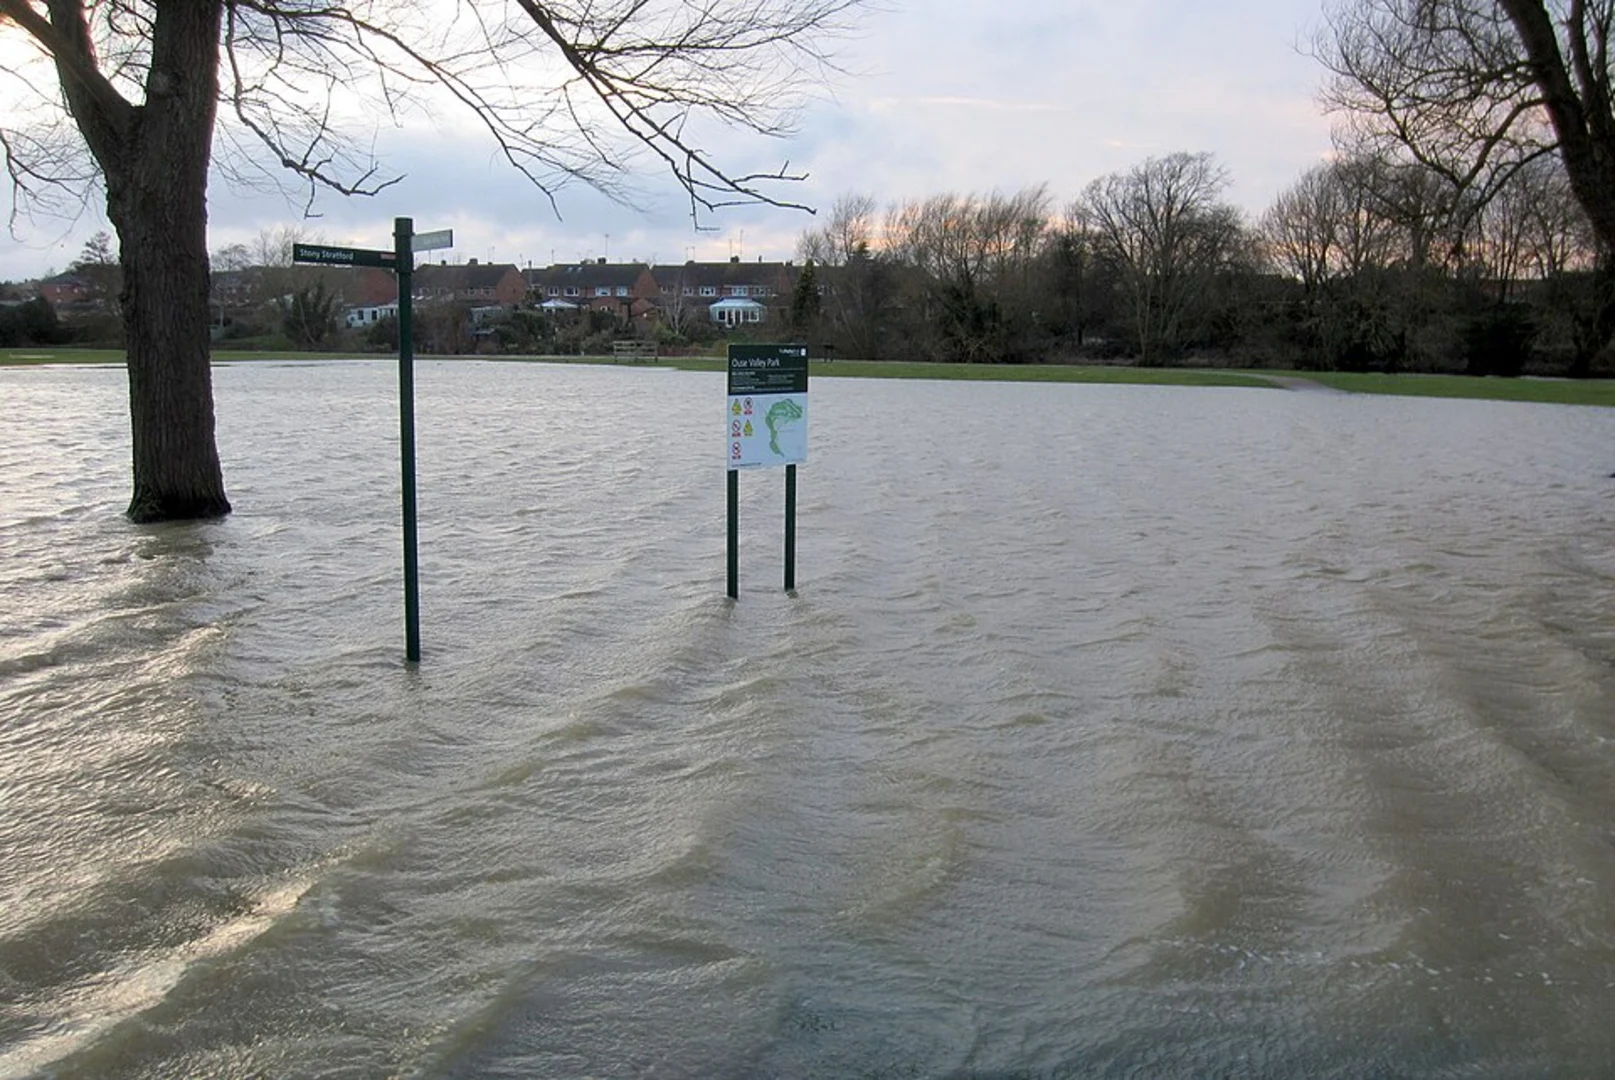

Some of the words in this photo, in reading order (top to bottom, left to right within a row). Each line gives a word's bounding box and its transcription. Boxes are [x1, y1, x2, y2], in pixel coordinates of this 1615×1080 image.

[300, 248, 320, 260] Stony
[321, 250, 354, 261] Stratford
[731, 358, 747, 368] Ouse
[748, 357, 766, 369] Valley
[767, 357, 780, 367] Park
